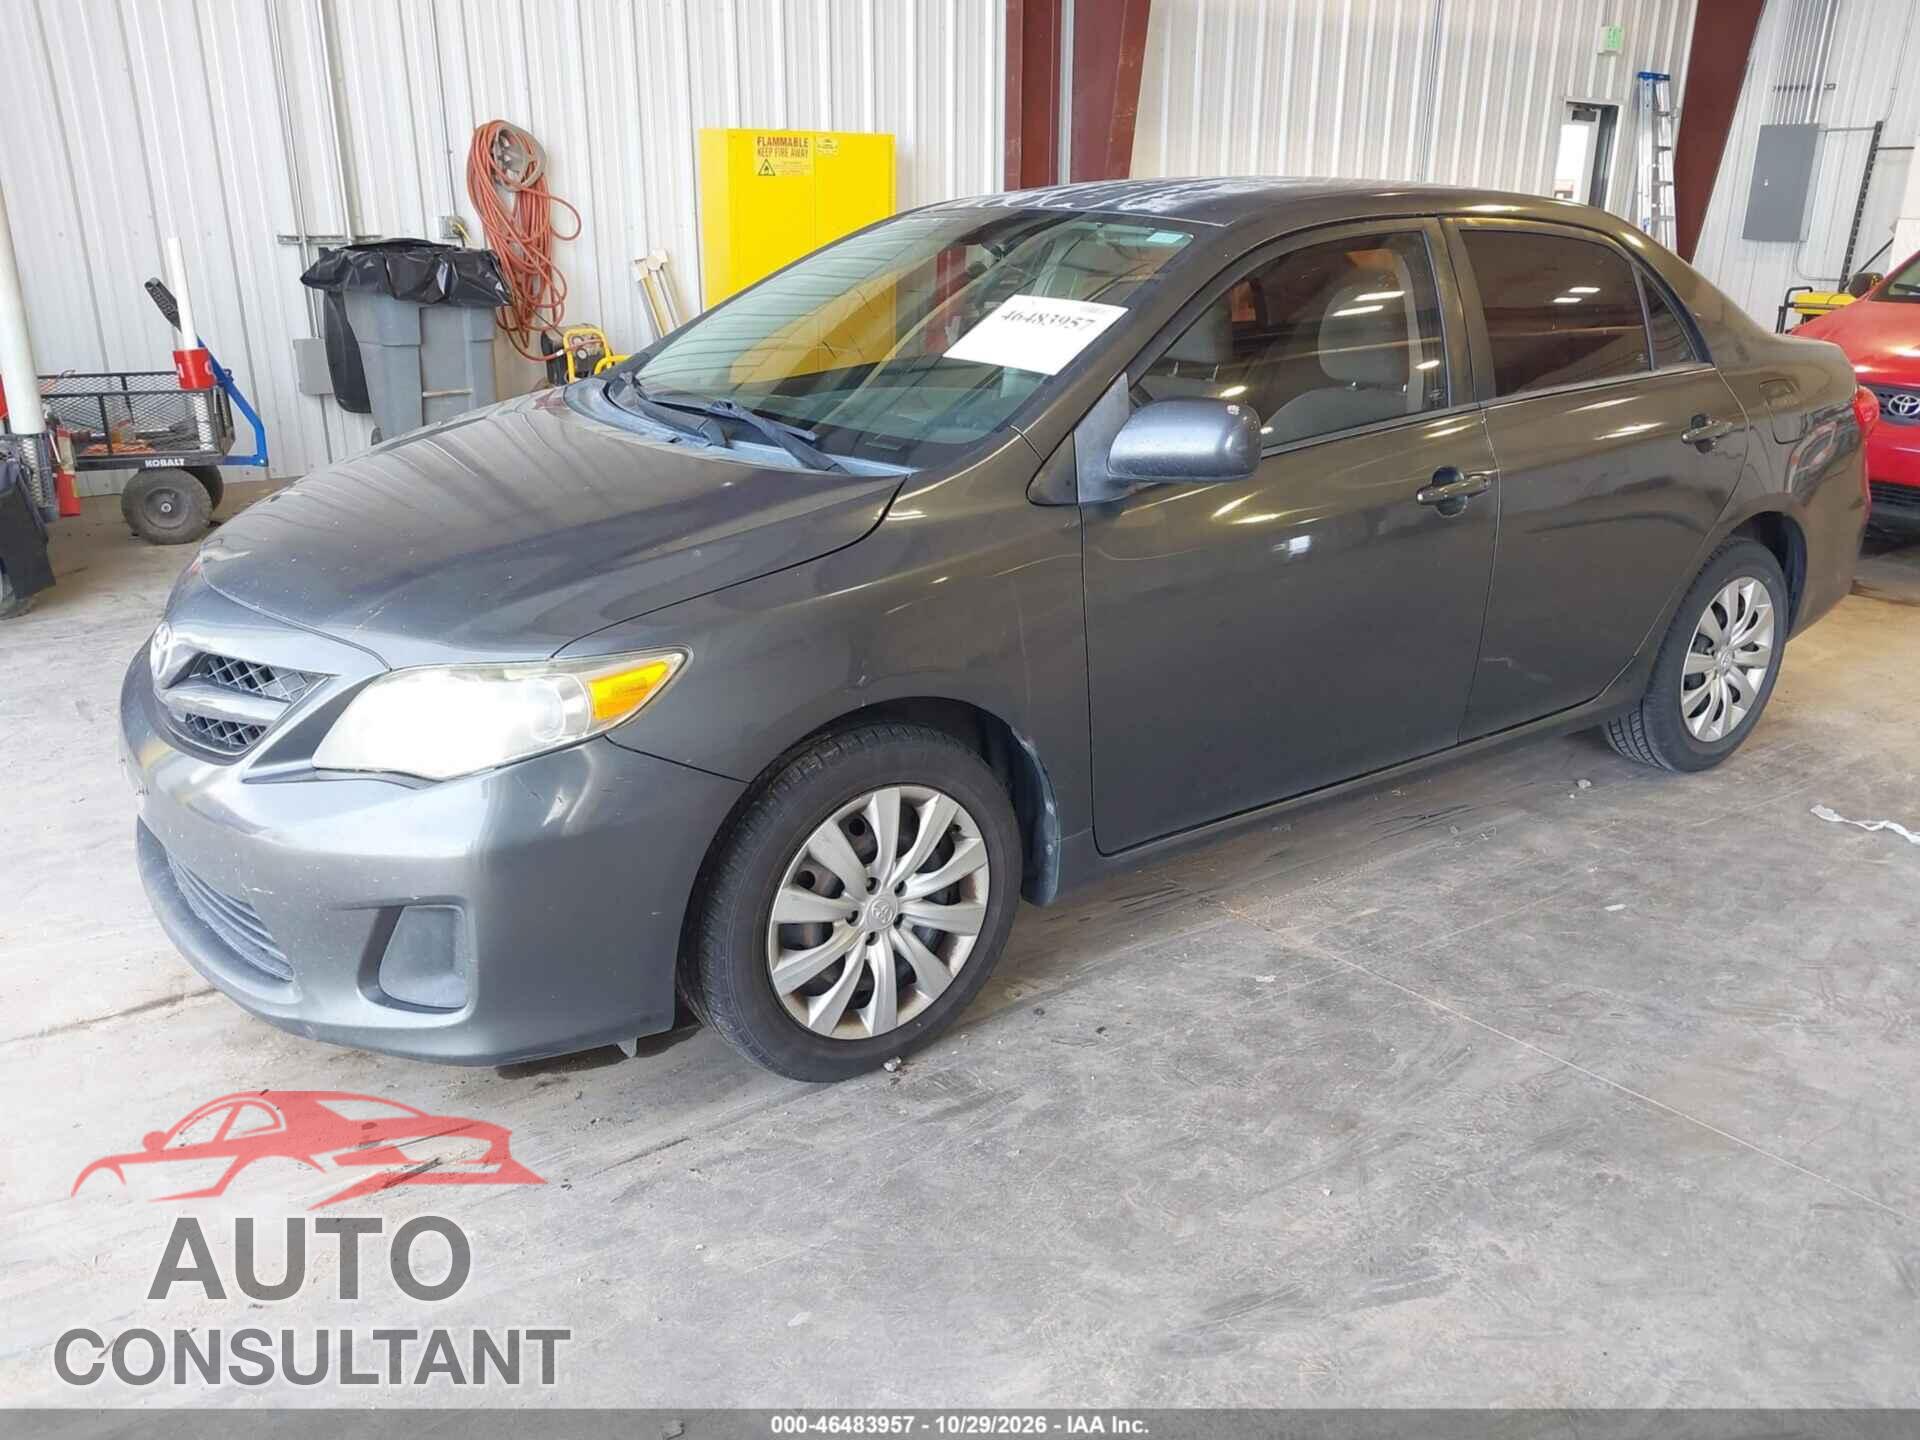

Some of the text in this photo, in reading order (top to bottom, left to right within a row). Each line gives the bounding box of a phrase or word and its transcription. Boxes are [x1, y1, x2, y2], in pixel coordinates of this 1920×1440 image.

[756, 136, 809, 148] FLAMMABLE
[757, 147, 809, 160] KEEP FIRE AWAY
[1000, 309, 1096, 331] 46483957
[144, 458, 185, 468] KOBALT
